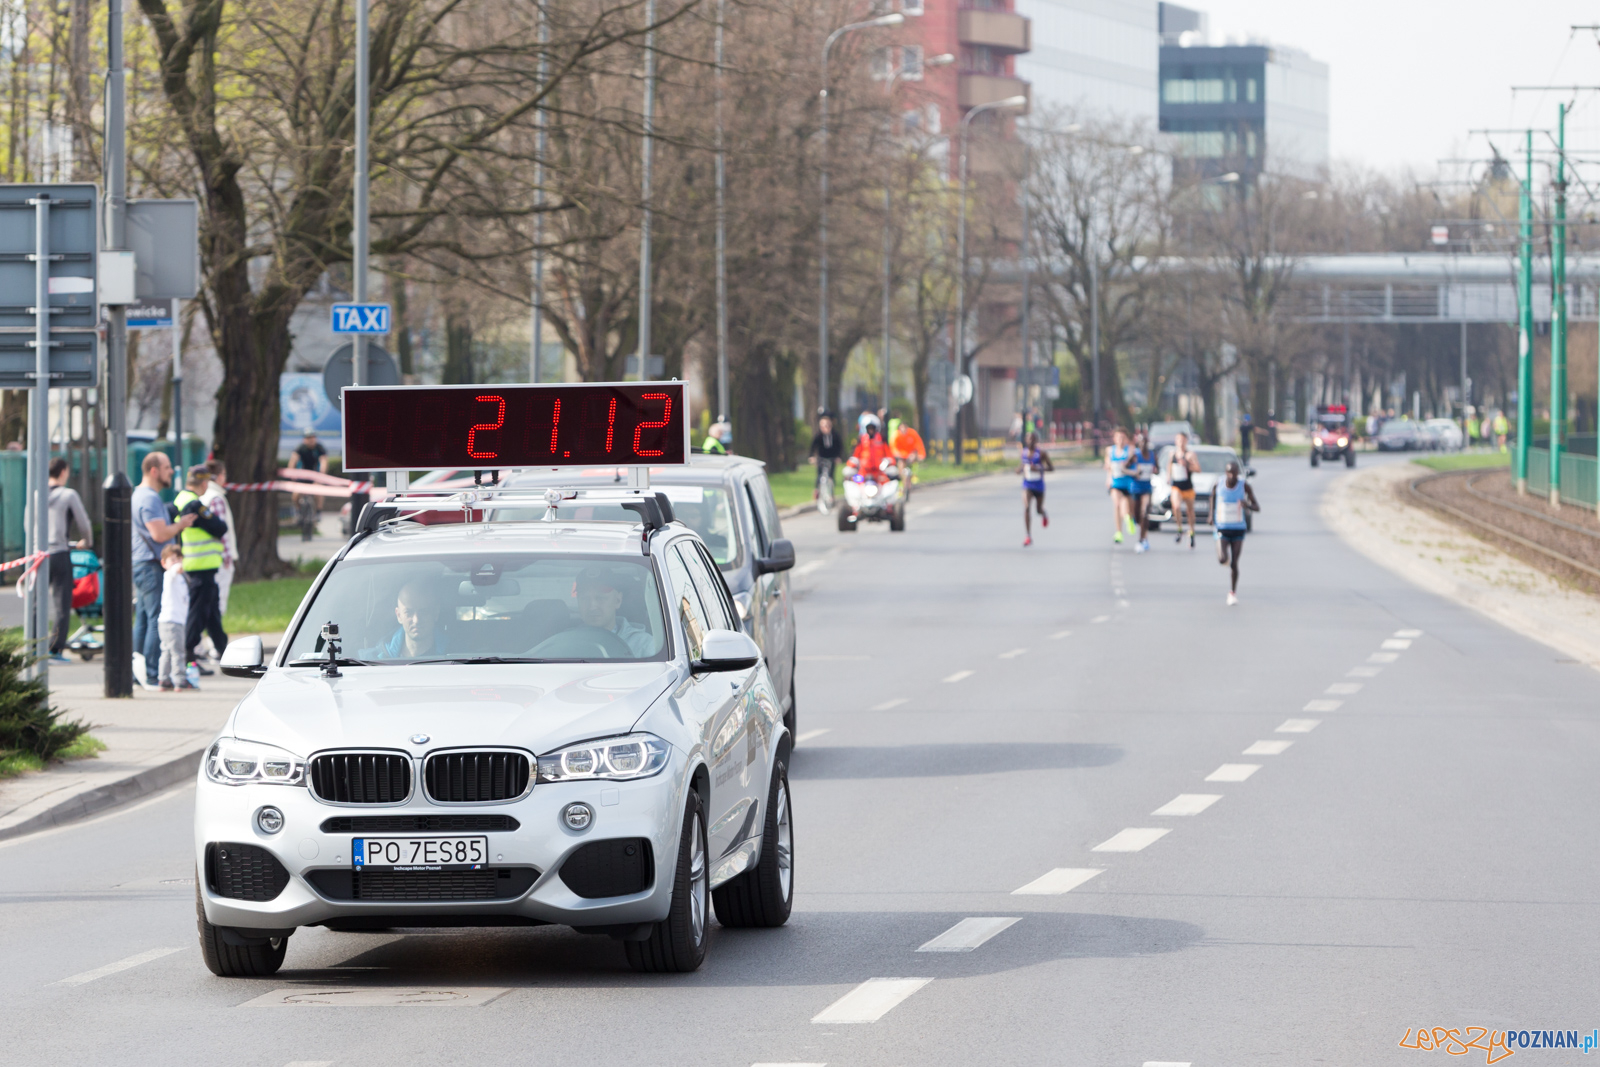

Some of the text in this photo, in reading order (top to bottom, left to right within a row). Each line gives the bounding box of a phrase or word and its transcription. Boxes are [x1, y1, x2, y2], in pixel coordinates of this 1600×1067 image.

[335, 307, 387, 330] TAXI
[467, 393, 672, 458] 21.12
[368, 841, 482, 863] PO 7ES85
